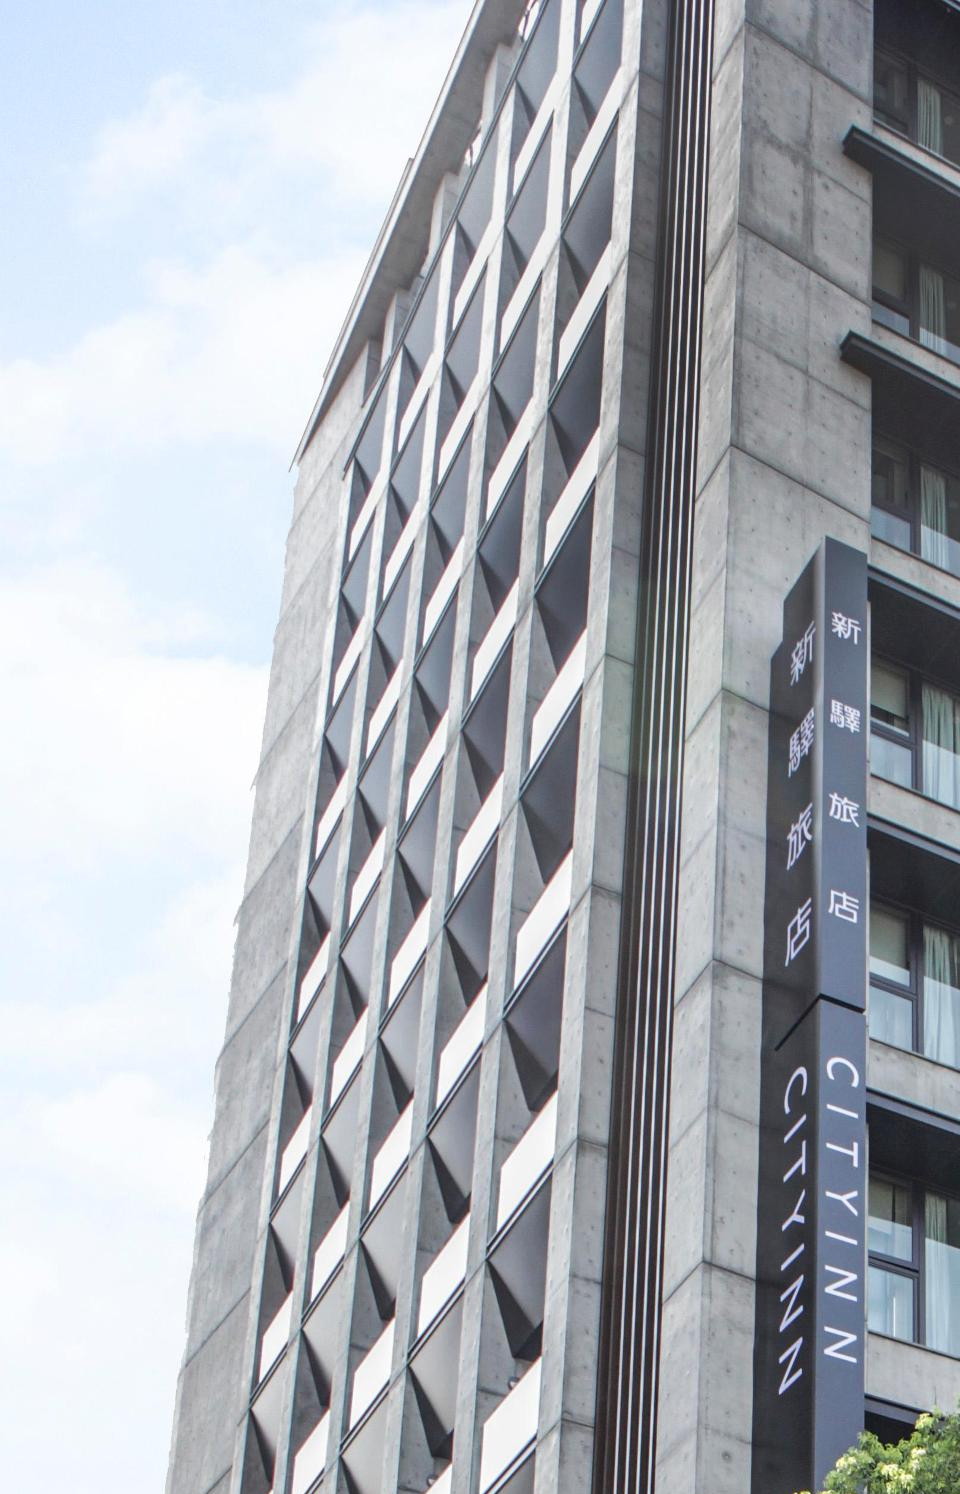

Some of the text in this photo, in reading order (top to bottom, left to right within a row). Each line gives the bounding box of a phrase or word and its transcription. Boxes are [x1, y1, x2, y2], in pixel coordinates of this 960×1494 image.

[785, 620, 817, 967] 新驛旅店
[828, 611, 862, 924] 新驛旅店
[777, 1066, 808, 1395] CITYINN
[823, 1056, 860, 1364] CITYINN
